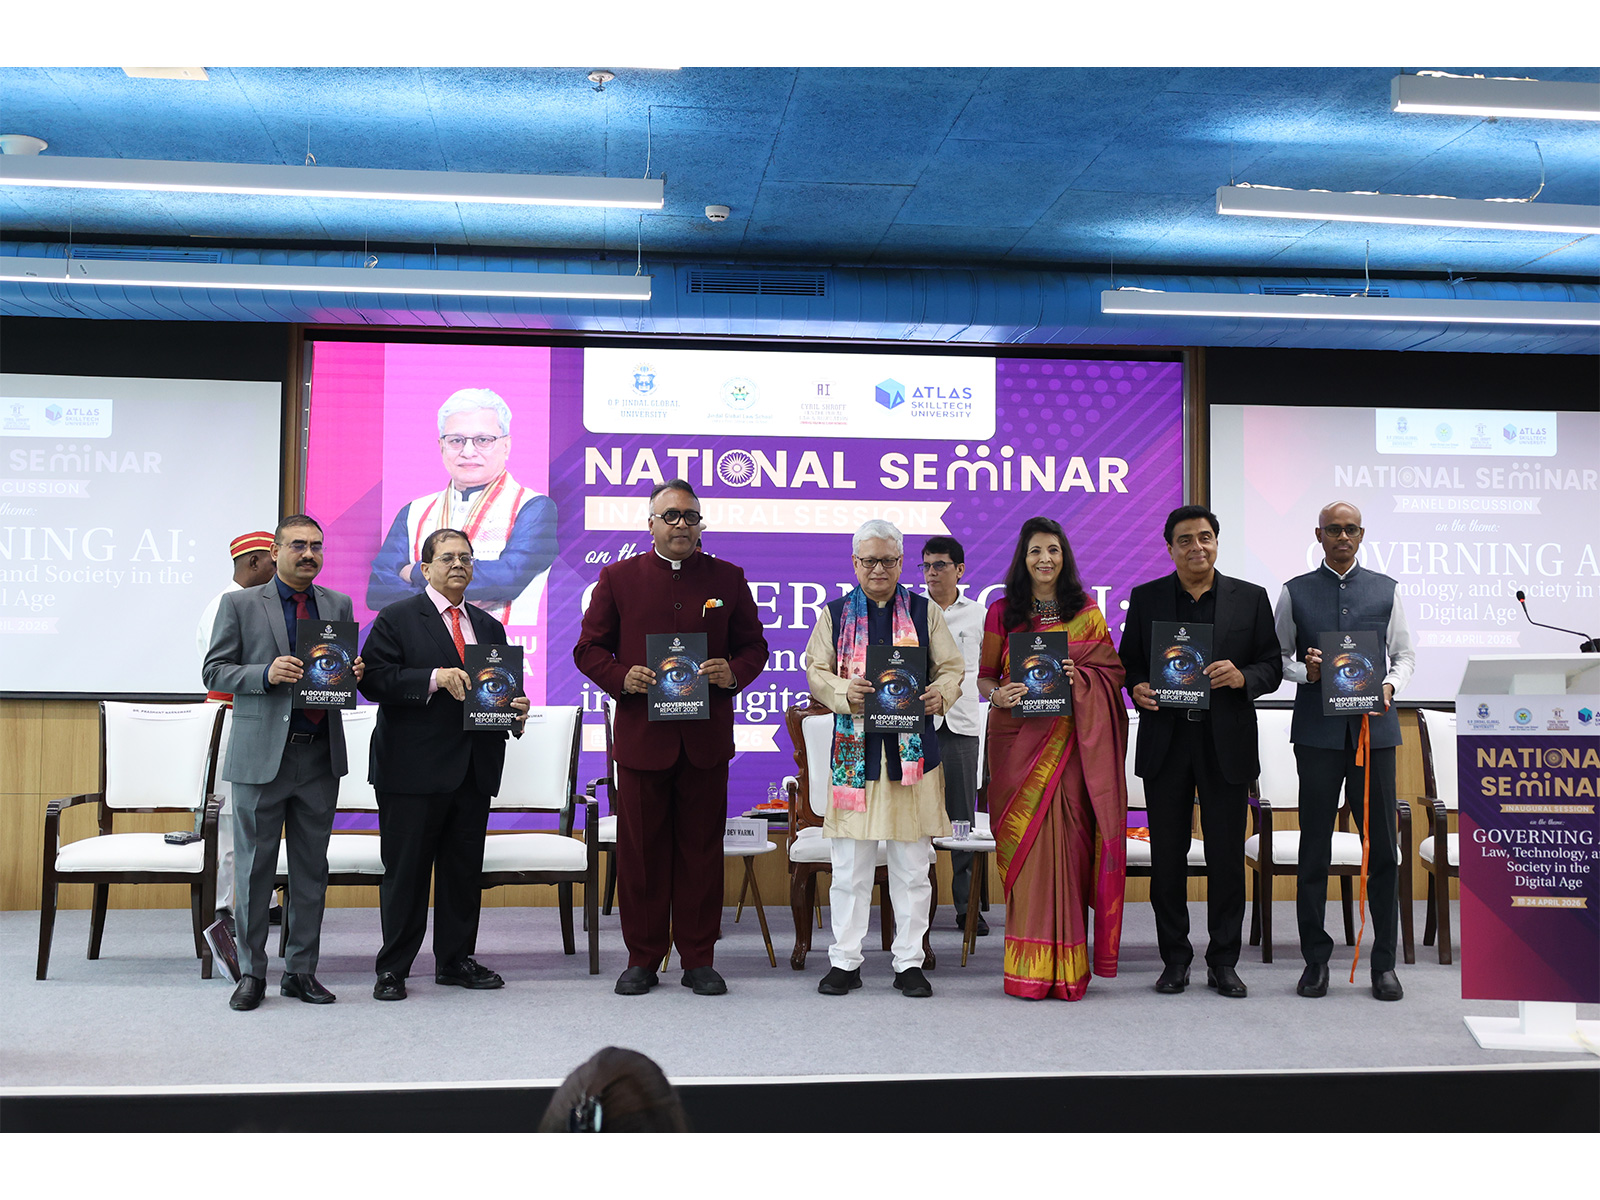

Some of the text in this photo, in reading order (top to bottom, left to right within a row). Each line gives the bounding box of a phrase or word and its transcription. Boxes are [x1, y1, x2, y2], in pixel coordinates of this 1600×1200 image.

[912, 386, 972, 400] ATLAS
[622, 399, 649, 407] JINDAL
[650, 399, 681, 408] GLOBAL
[911, 402, 972, 410] SKILLTECH
[66, 408, 100, 416] ATLAS
[620, 410, 668, 418] UNIVERSITY
[1519, 427, 1547, 435] ATLAS
[584, 446, 856, 489] NATIONAL
[1334, 464, 1465, 490] NATIONAL
[1402, 498, 1534, 512] PANEL DISCUSSION
[598, 502, 927, 528] INAURAL SESSION
[1435, 520, 1500, 533] on the theme:
[129, 528, 196, 564] AI:
[584, 549, 612, 564] on
[45, 565, 125, 588] Society
[131, 566, 152, 584] in
[159, 566, 194, 584] the
[1400, 579, 1463, 600] nology,
[1472, 580, 1502, 597] and
[1508, 580, 1572, 602] Society
[1575, 582, 1590, 598] in
[14, 589, 56, 612] Age
[1419, 602, 1518, 626] Digital Age
[17, 620, 48, 632] 2026
[1440, 634, 1512, 644] 24 APRIL 2026
[1162, 689, 1204, 697] GOVERNANCE
[1472, 828, 1593, 845] GOVERNING
[1482, 846, 1510, 858] Law,
[1512, 847, 1588, 861] Technology,
[1506, 861, 1590, 875] Society in the
[1515, 876, 1583, 890] Digital Age
